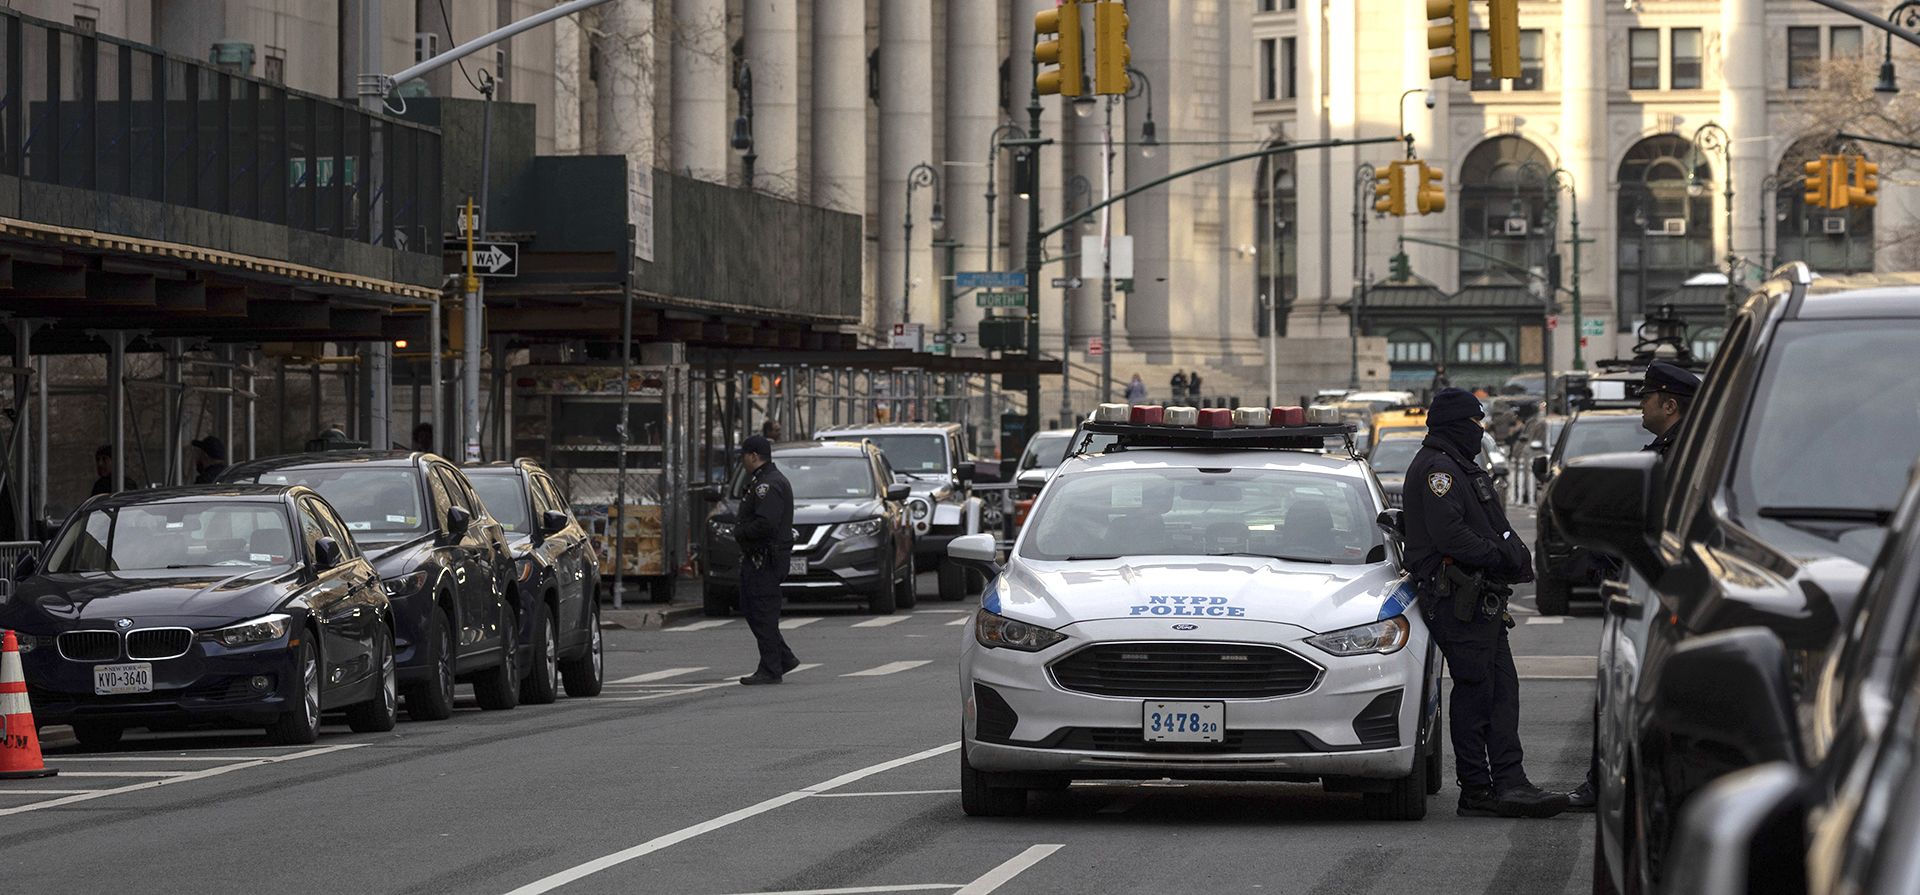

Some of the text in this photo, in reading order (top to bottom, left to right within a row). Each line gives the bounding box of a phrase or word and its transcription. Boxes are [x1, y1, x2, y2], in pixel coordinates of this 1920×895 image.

[475, 252, 502, 265] WAY
[978, 294, 1015, 306] WORTH
[1149, 595, 1228, 605] NYPD
[1129, 605, 1245, 617] POLICE
[1151, 712, 1217, 733] 3478 20
